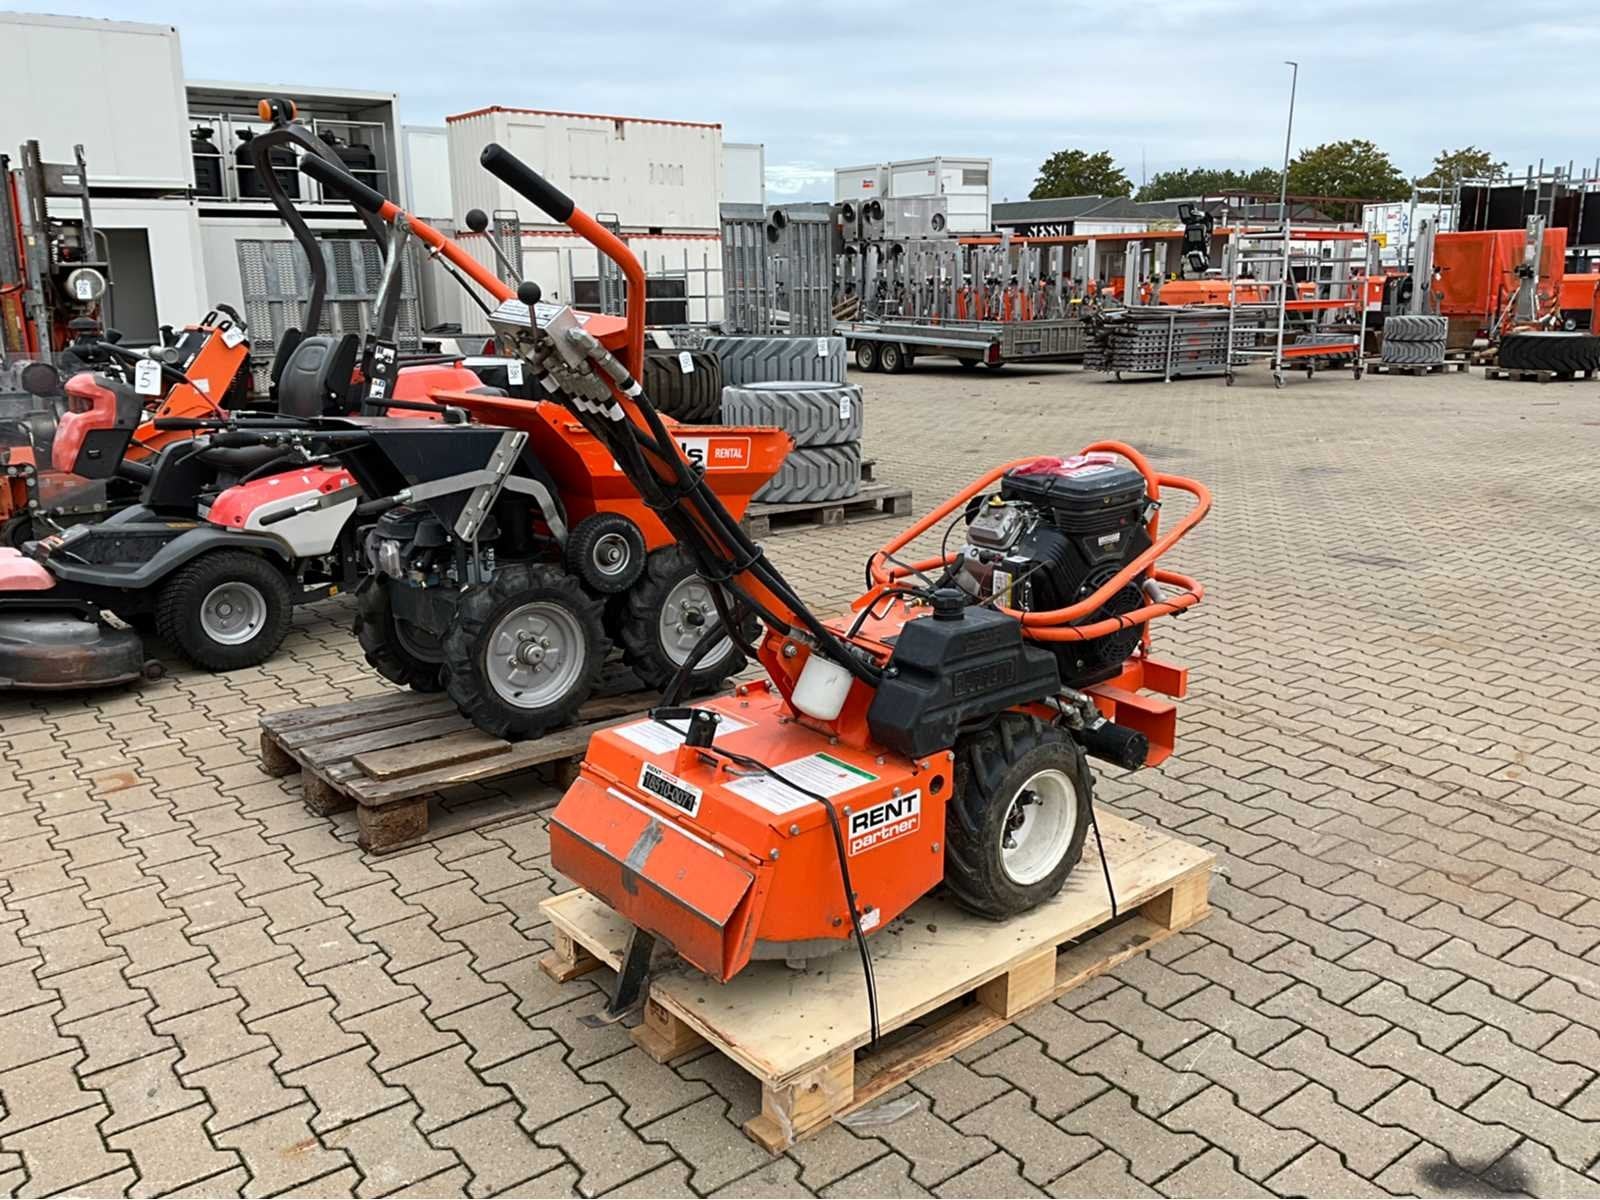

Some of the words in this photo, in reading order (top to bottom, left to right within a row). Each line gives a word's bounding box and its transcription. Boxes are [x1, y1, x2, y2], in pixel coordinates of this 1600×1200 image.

[139, 371, 151, 389] 5
[714, 447, 743, 459] RENTAL
[852, 793, 918, 834] RENT
[852, 818, 917, 854] partner
